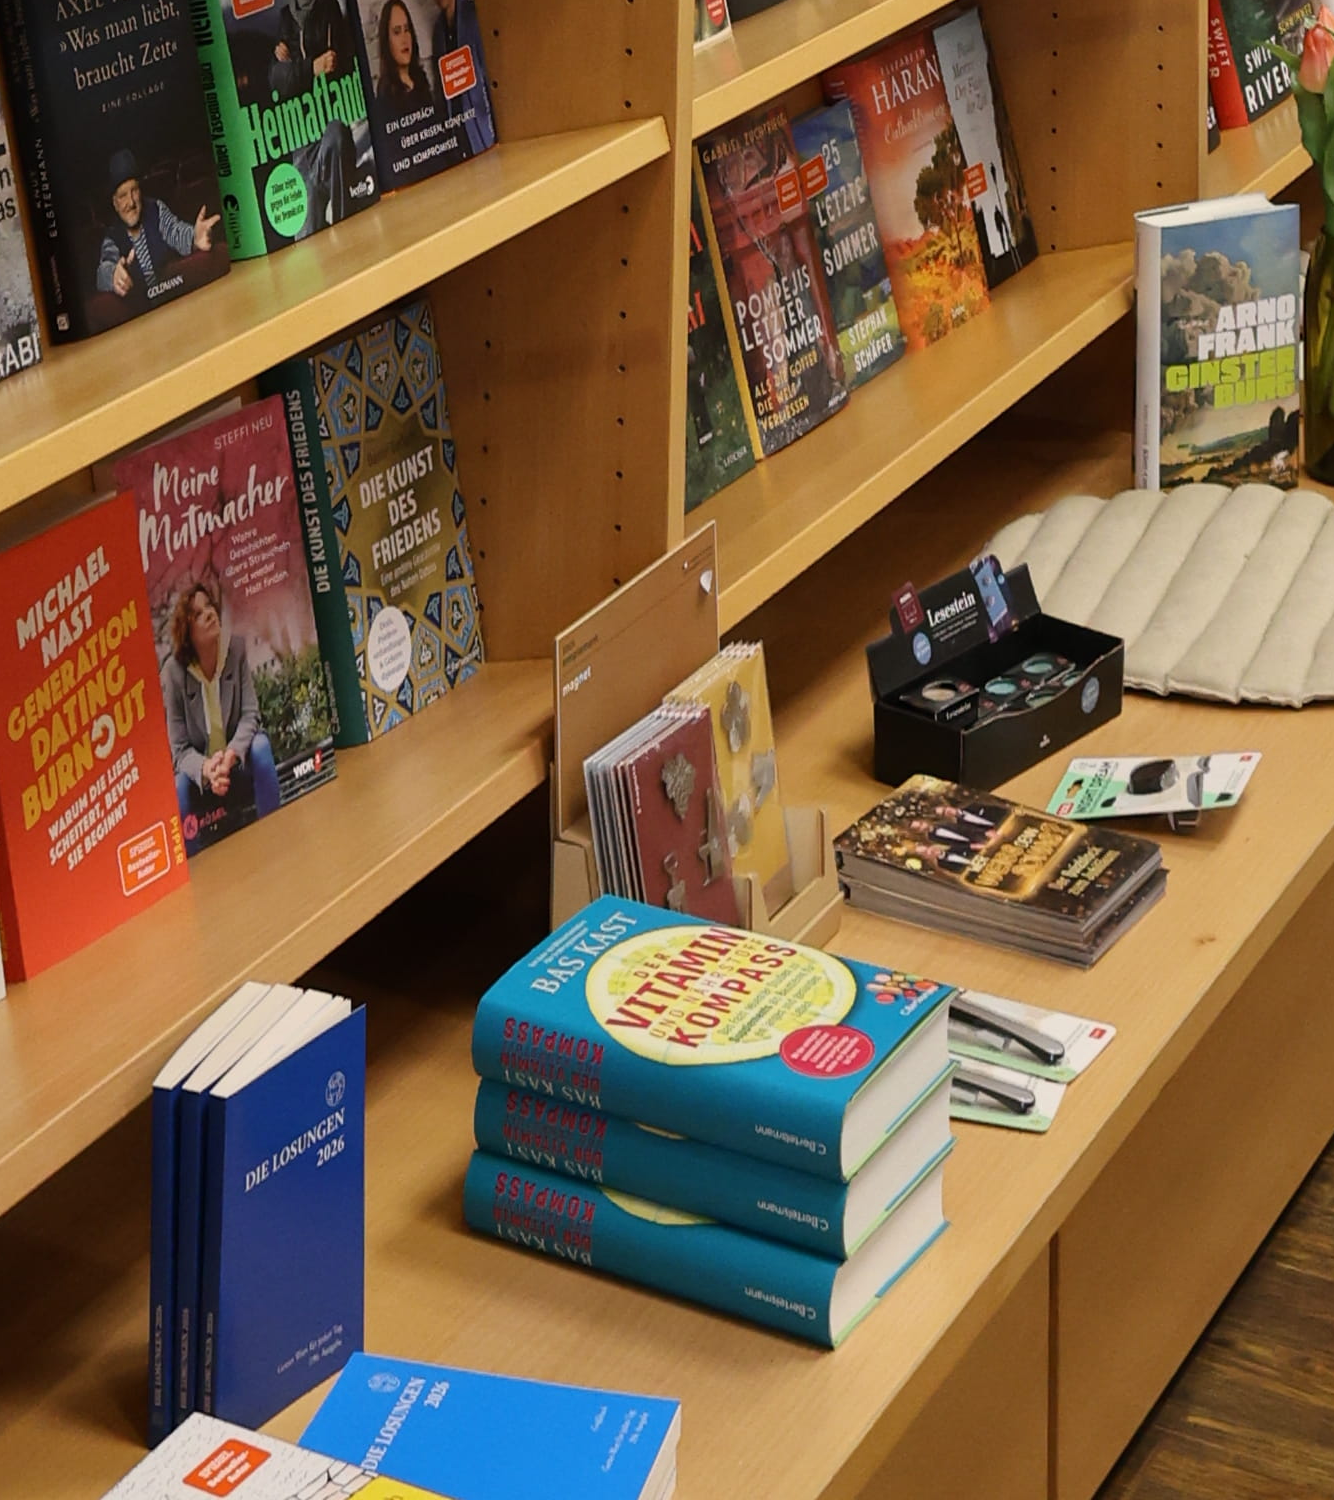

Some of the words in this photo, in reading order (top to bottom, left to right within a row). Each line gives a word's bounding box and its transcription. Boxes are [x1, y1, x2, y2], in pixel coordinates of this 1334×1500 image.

[847, 310, 887, 346] STEPHAN
[1216, 293, 1296, 334] ARNO
[764, 315, 823, 370] SOMMER
[1198, 323, 1296, 361] FRANK
[214, 426, 249, 450] STEFFI
[251, 416, 272, 433] NEU
[152, 461, 219, 512] Meine
[16, 545, 109, 650] MICHAEL
[927, 592, 976, 627] Lesestein
[41, 596, 93, 668] NAST
[531, 956, 585, 996] BAS
[579, 912, 637, 959] KAST
[606, 926, 748, 1032] VITAMIN
[244, 1161, 269, 1194] DIE
[272, 1108, 347, 1177] LOSUNGEN
[315, 1136, 345, 1167] 2026
[495, 1172, 596, 1222] KOMPASS
